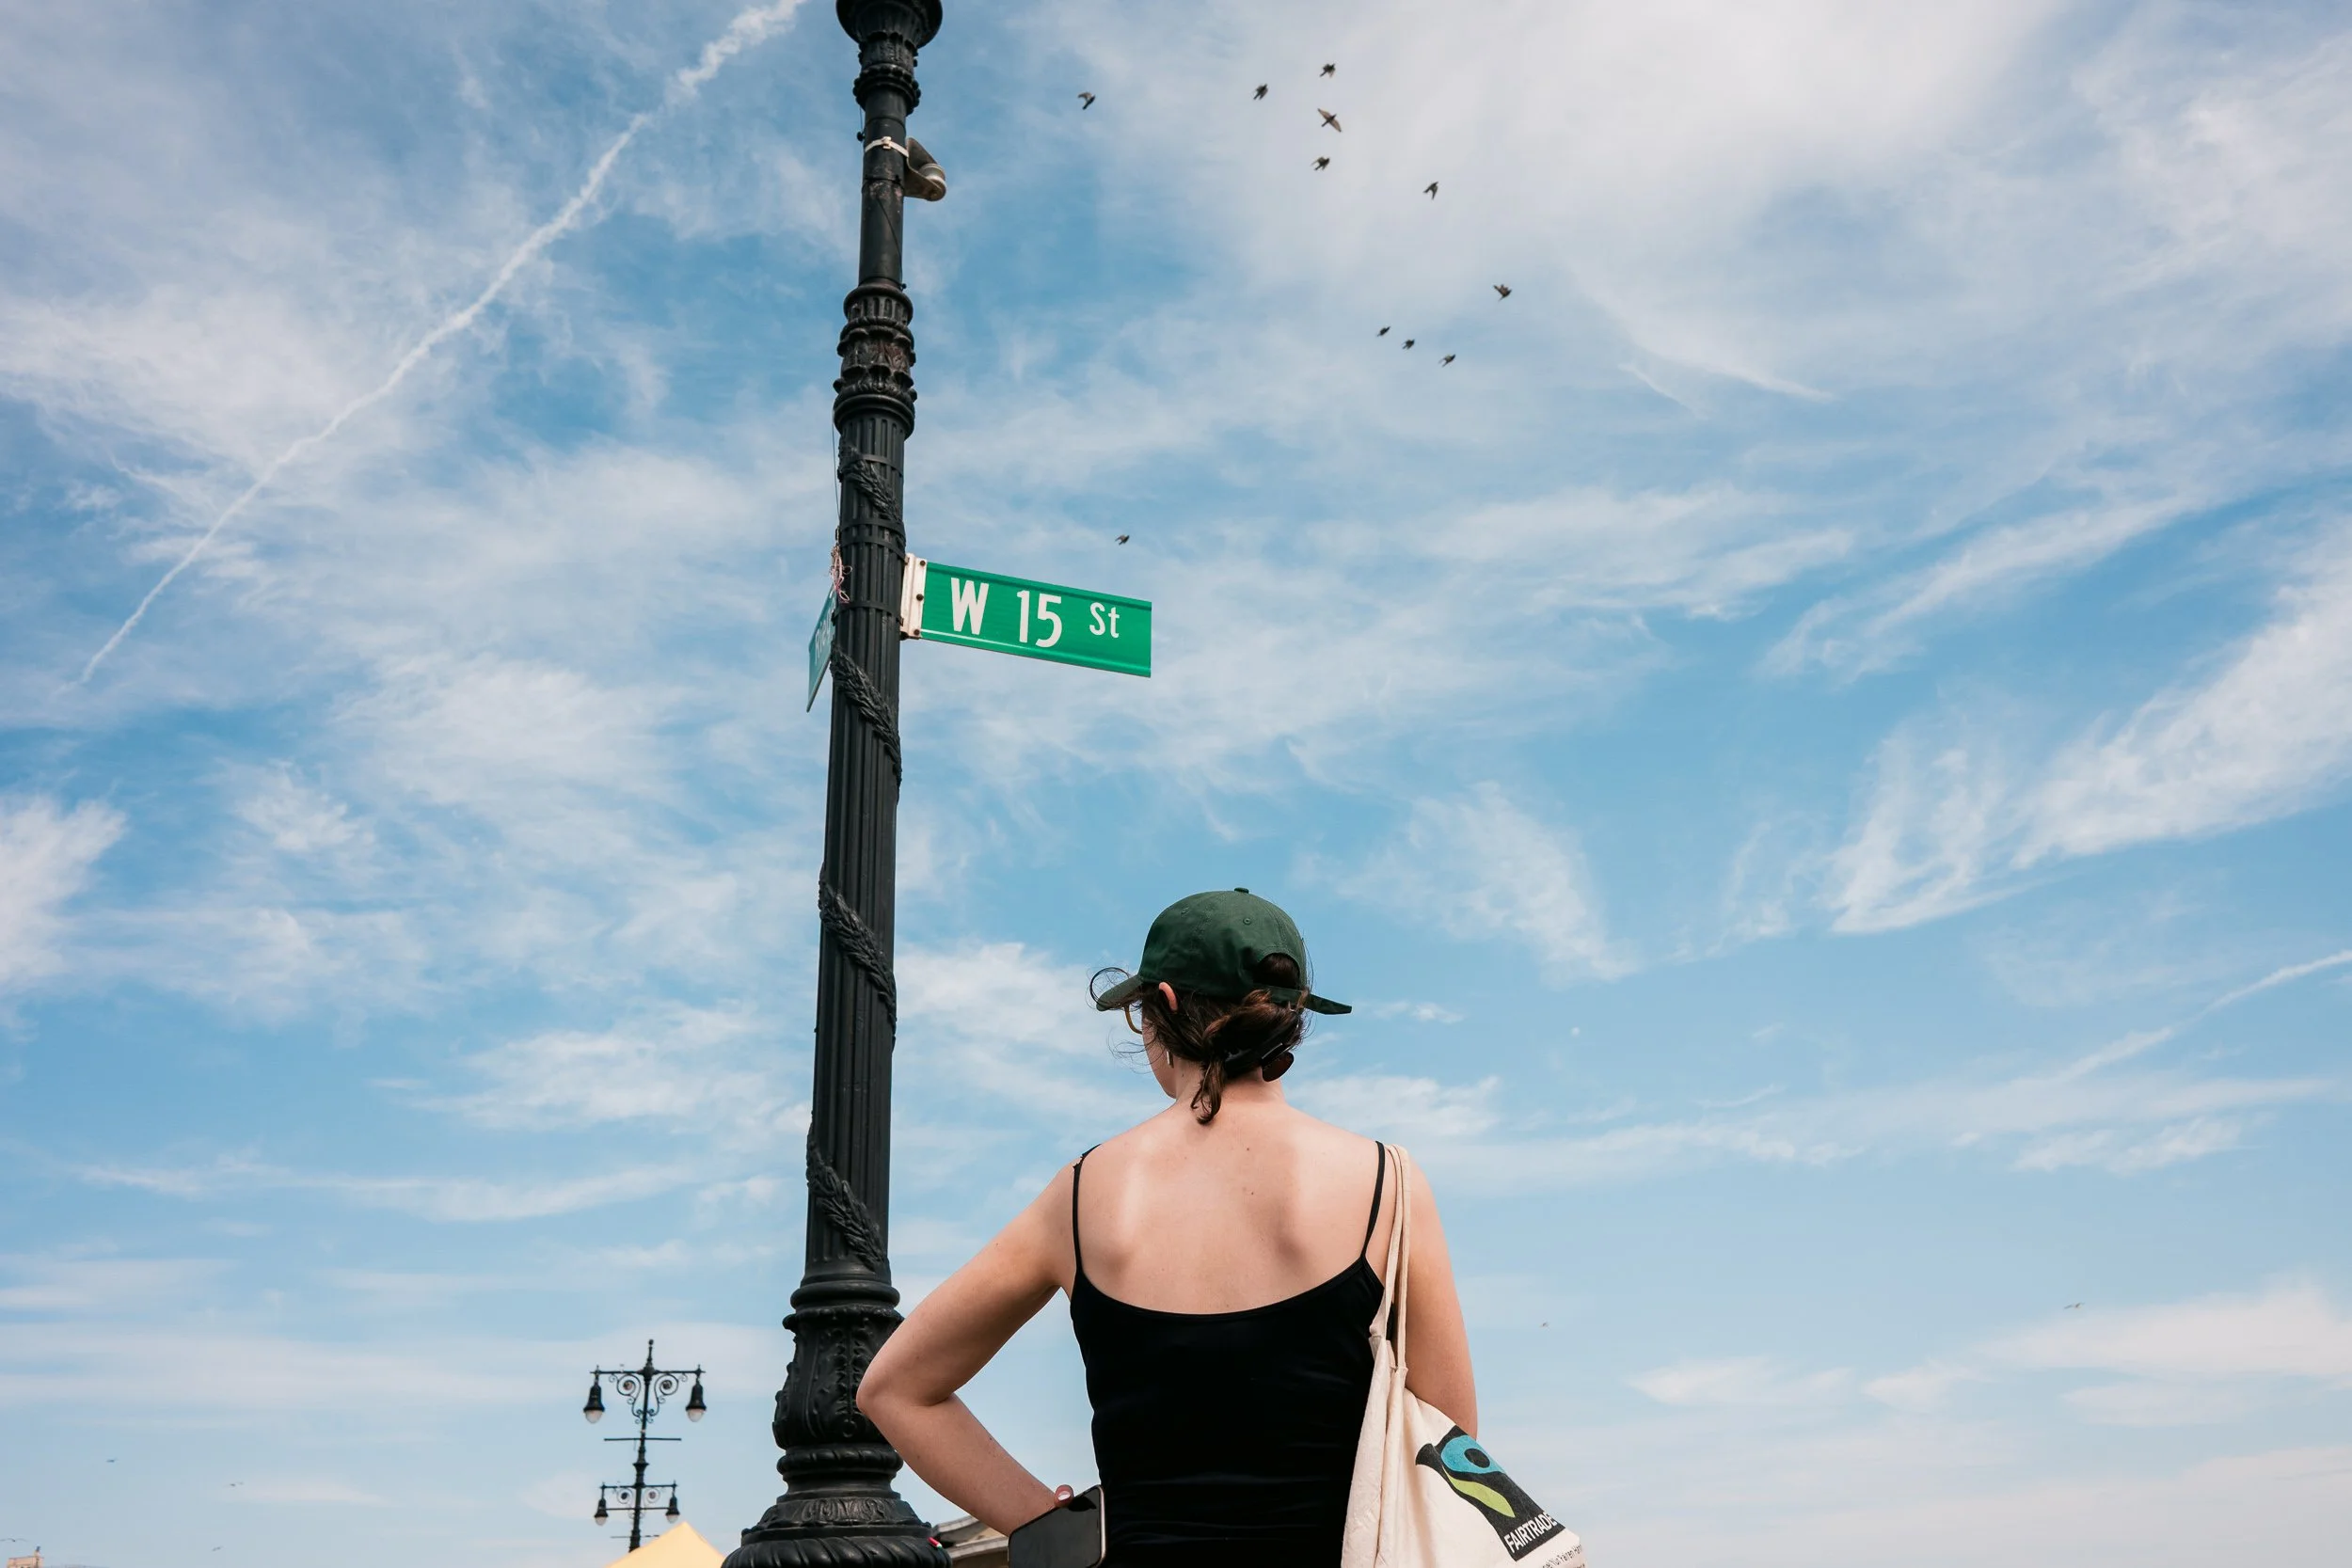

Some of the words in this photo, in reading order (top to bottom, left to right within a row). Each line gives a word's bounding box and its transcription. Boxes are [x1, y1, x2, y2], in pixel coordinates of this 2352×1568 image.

[950, 577, 989, 635] W
[1017, 590, 1062, 648] 15
[1089, 602, 1120, 639] St
[1504, 1512, 1558, 1553] FAIRTRADE
